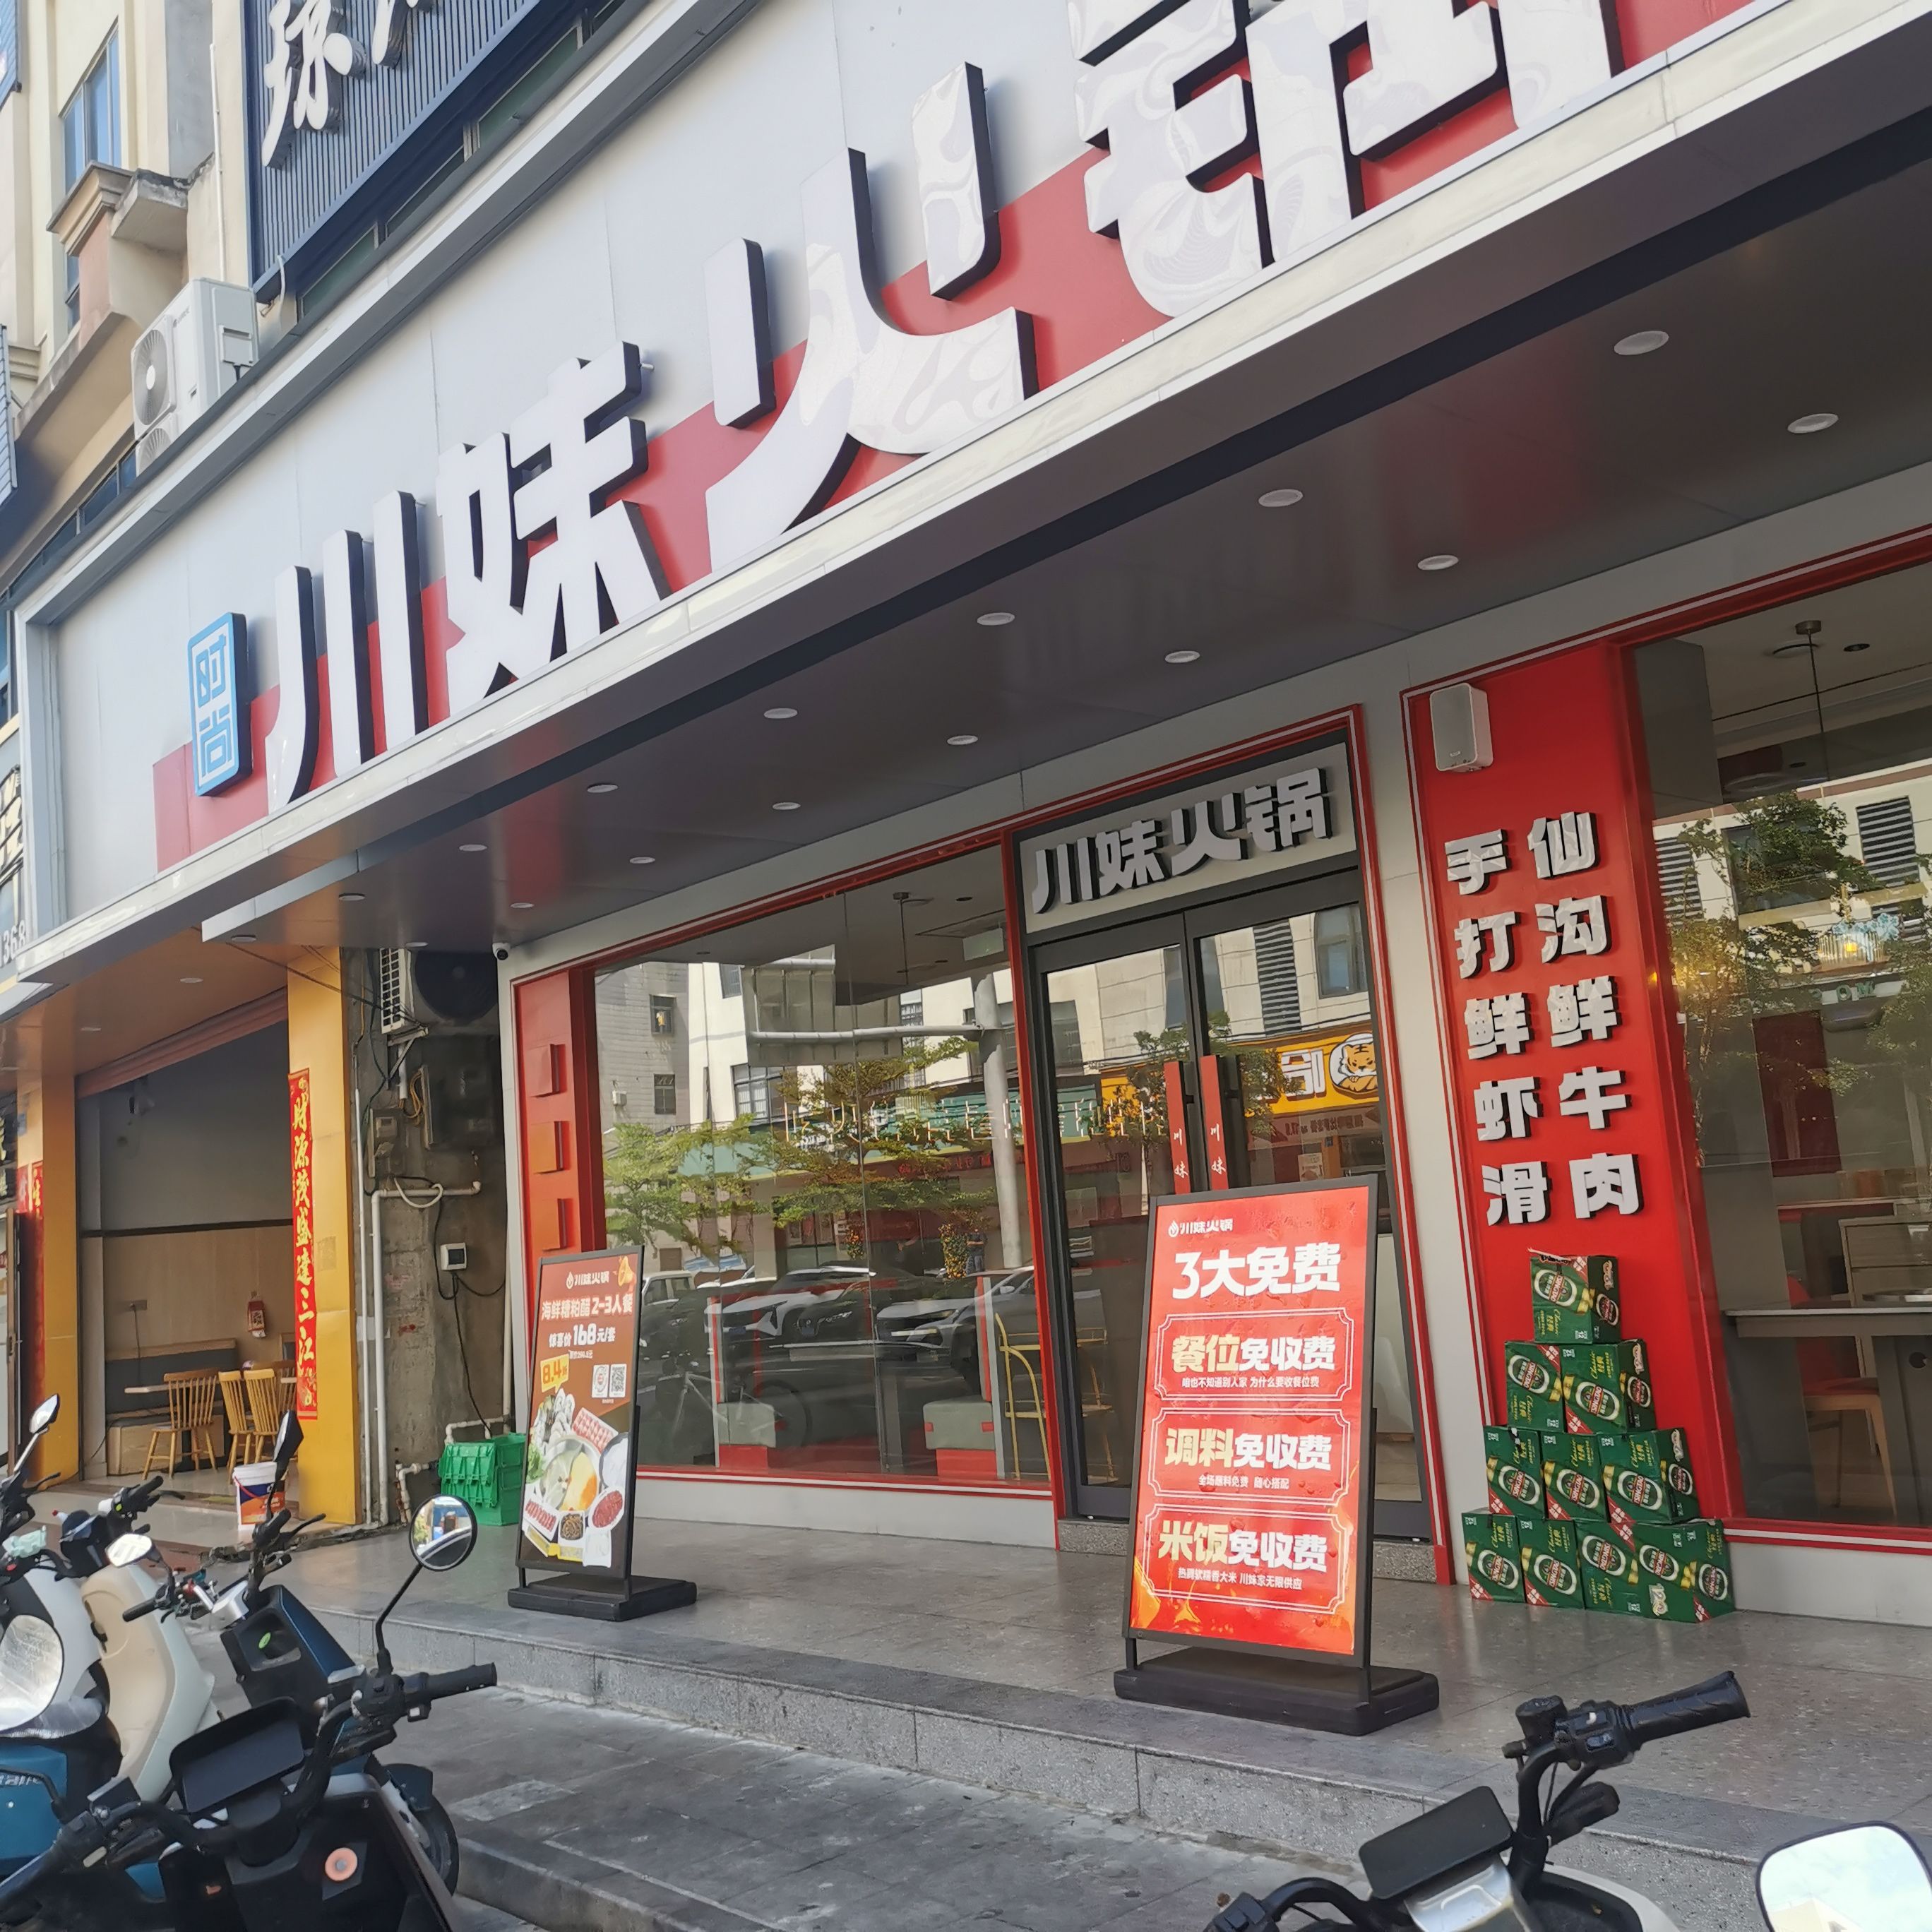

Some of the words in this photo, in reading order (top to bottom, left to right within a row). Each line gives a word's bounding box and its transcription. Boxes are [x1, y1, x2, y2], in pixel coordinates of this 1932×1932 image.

[195, 633, 232, 779] 时尚
[1032, 768, 1329, 914] 川妹火锅
[1445, 829, 1549, 1226] 手打鲜虾滑
[1527, 811, 1641, 1219] 仙沟鲜牛肉
[1174, 1128, 1188, 1179] 川妹
[1210, 1123, 1226, 1175] 川妹
[1179, 1218, 1233, 1235] 川妹火锅
[1172, 1241, 1342, 1299] 3大免费
[1171, 1333, 1336, 1373] 餐位免收费
[1249, 1376, 1320, 1388] 为什么要收餐位费
[1164, 1428, 1332, 1471] 调料免收费
[1157, 1520, 1328, 1573] 米饭免收费
